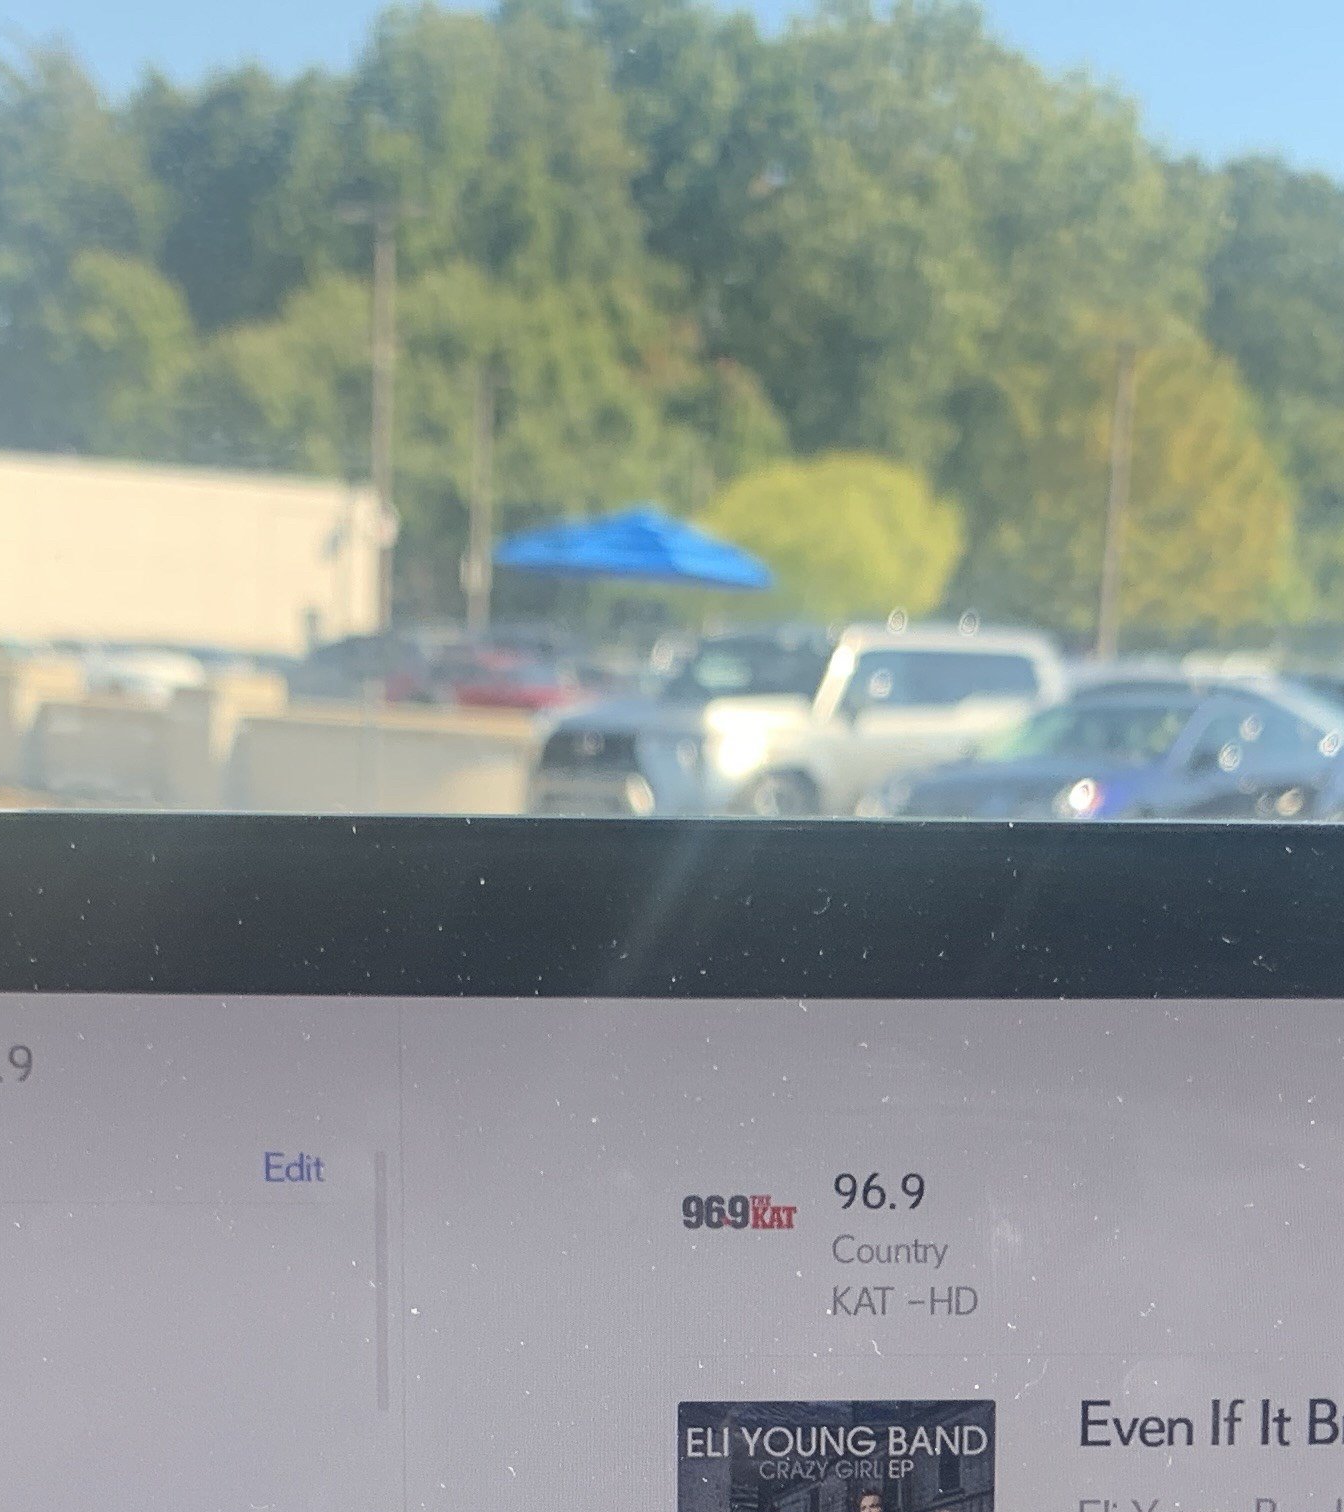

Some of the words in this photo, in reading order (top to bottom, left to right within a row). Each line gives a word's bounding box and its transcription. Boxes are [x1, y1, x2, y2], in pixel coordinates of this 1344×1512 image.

[263, 1151, 325, 1183] Edit
[833, 1172, 926, 1210] 96.9
[751, 1205, 798, 1230] KAT
[831, 1234, 950, 1270] Country
[831, 1285, 896, 1317] KAT
[1080, 1399, 1195, 1448] Even
[1210, 1398, 1244, 1447] If
[1259, 1398, 1292, 1447] It
[686, 1427, 731, 1459] ELI
[740, 1426, 877, 1458] YOUNG
[888, 1425, 988, 1457] BAND
[758, 1460, 828, 1480] CRAZY
[835, 1459, 883, 1479] GIRL
[888, 1459, 915, 1479] EP
